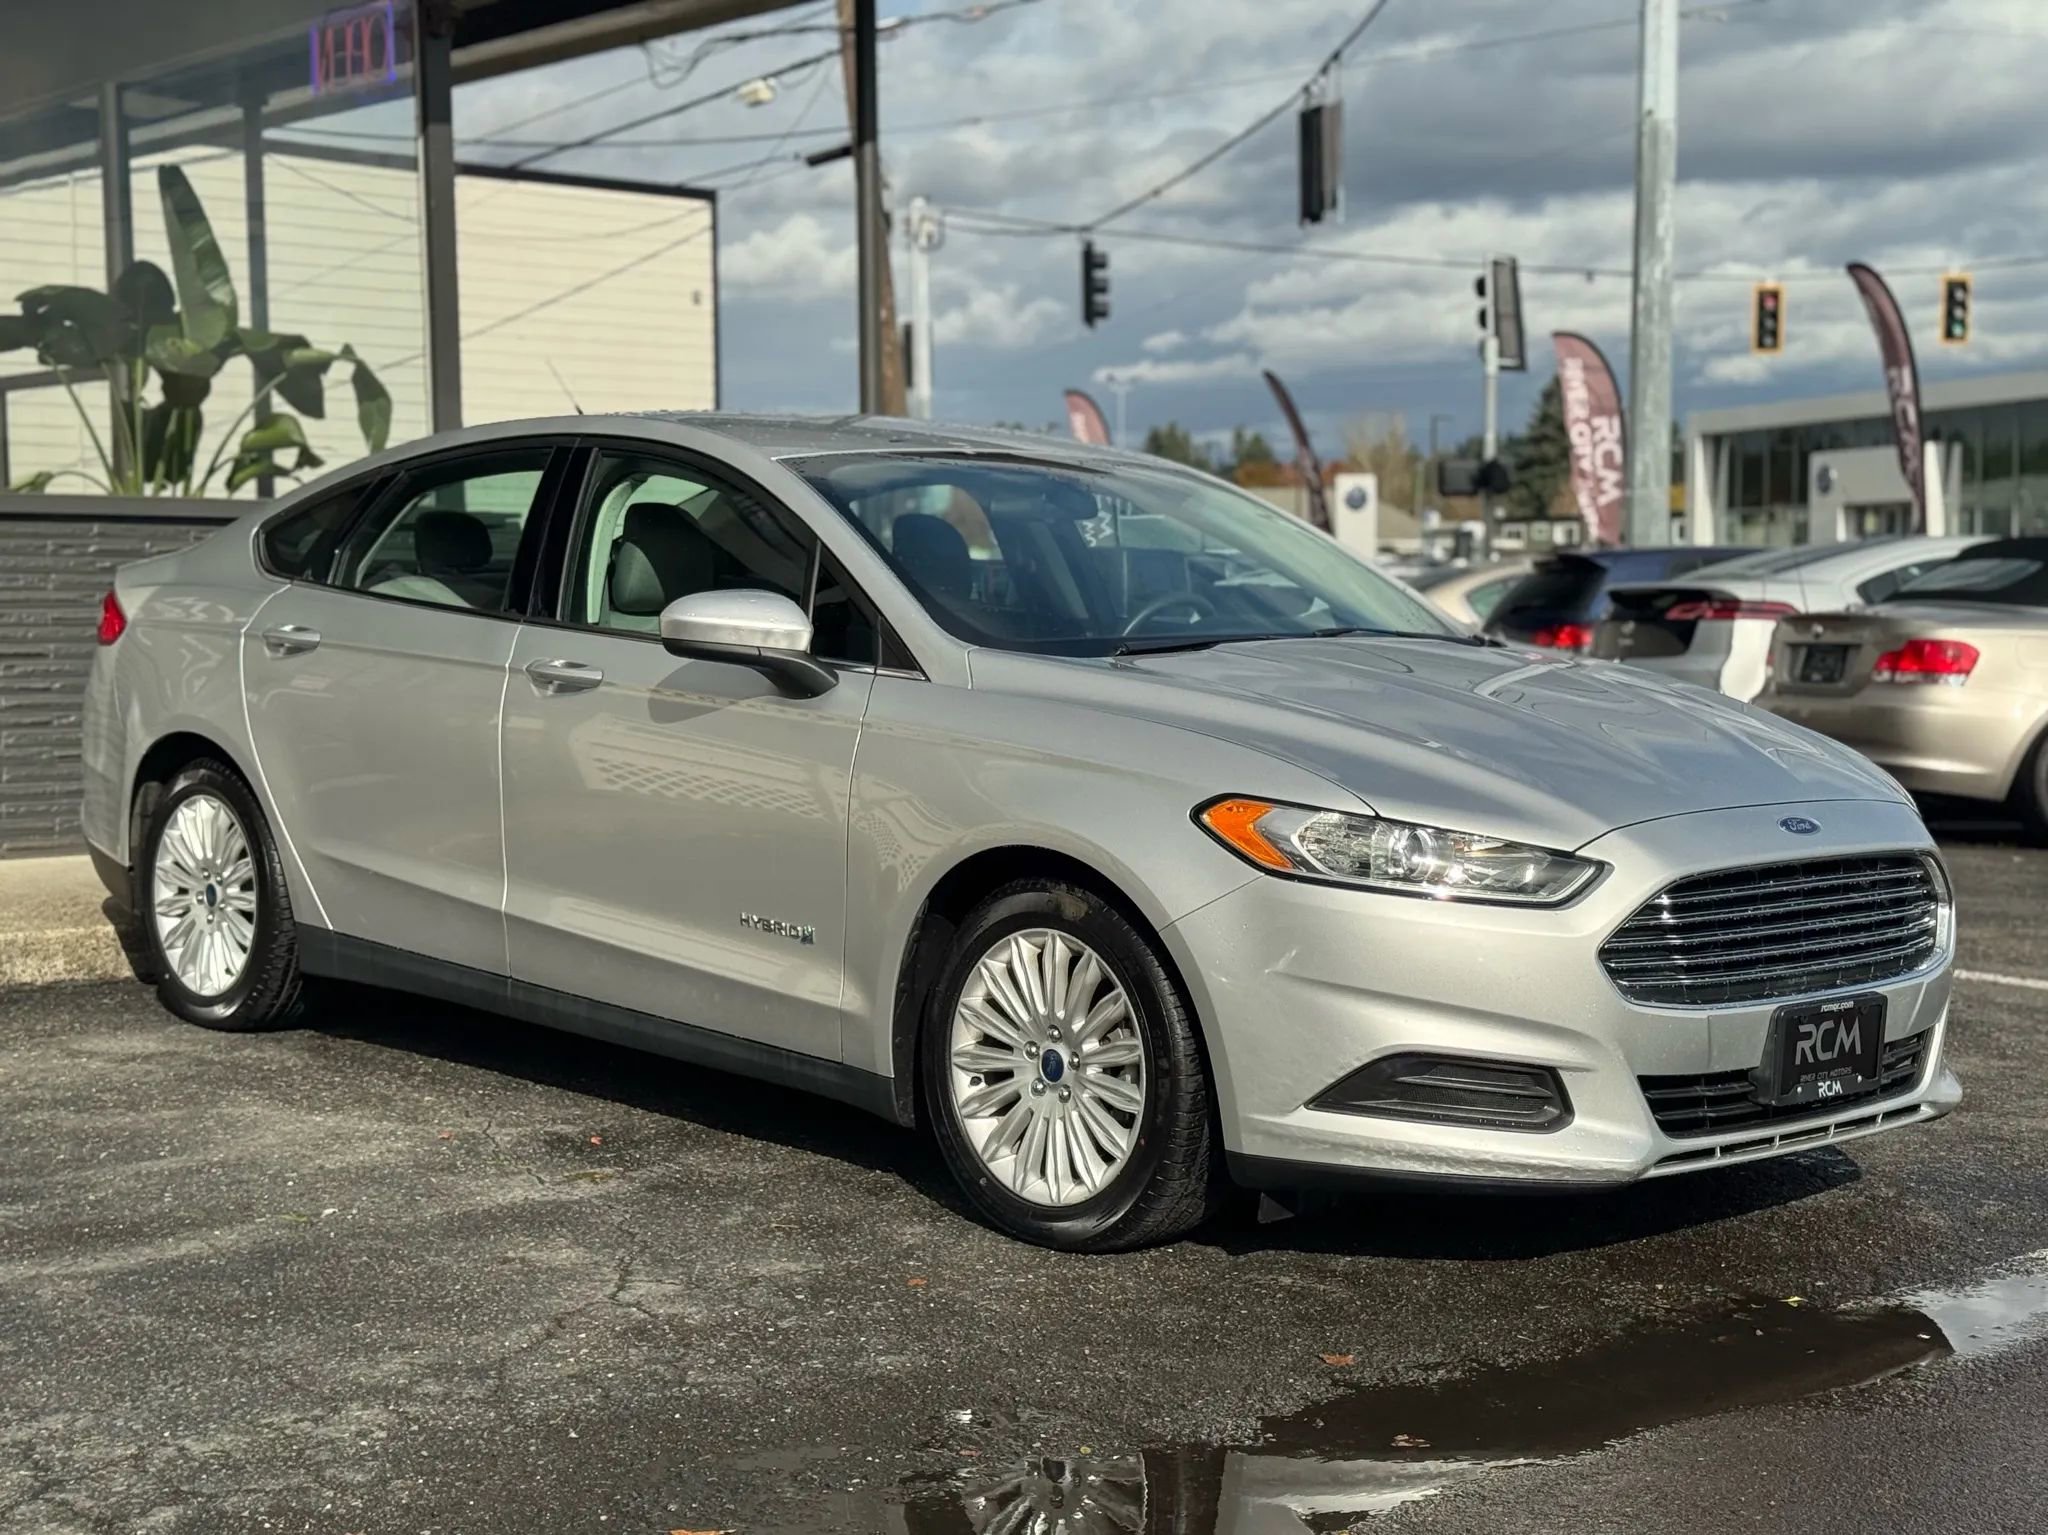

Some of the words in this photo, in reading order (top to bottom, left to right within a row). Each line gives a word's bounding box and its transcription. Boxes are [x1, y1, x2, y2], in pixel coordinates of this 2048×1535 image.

[1590, 415, 1623, 507] RCM
[740, 912, 801, 939] HYBRID
[1795, 1017, 1862, 1065] RCM
[1817, 1080, 1843, 1098] RCM
